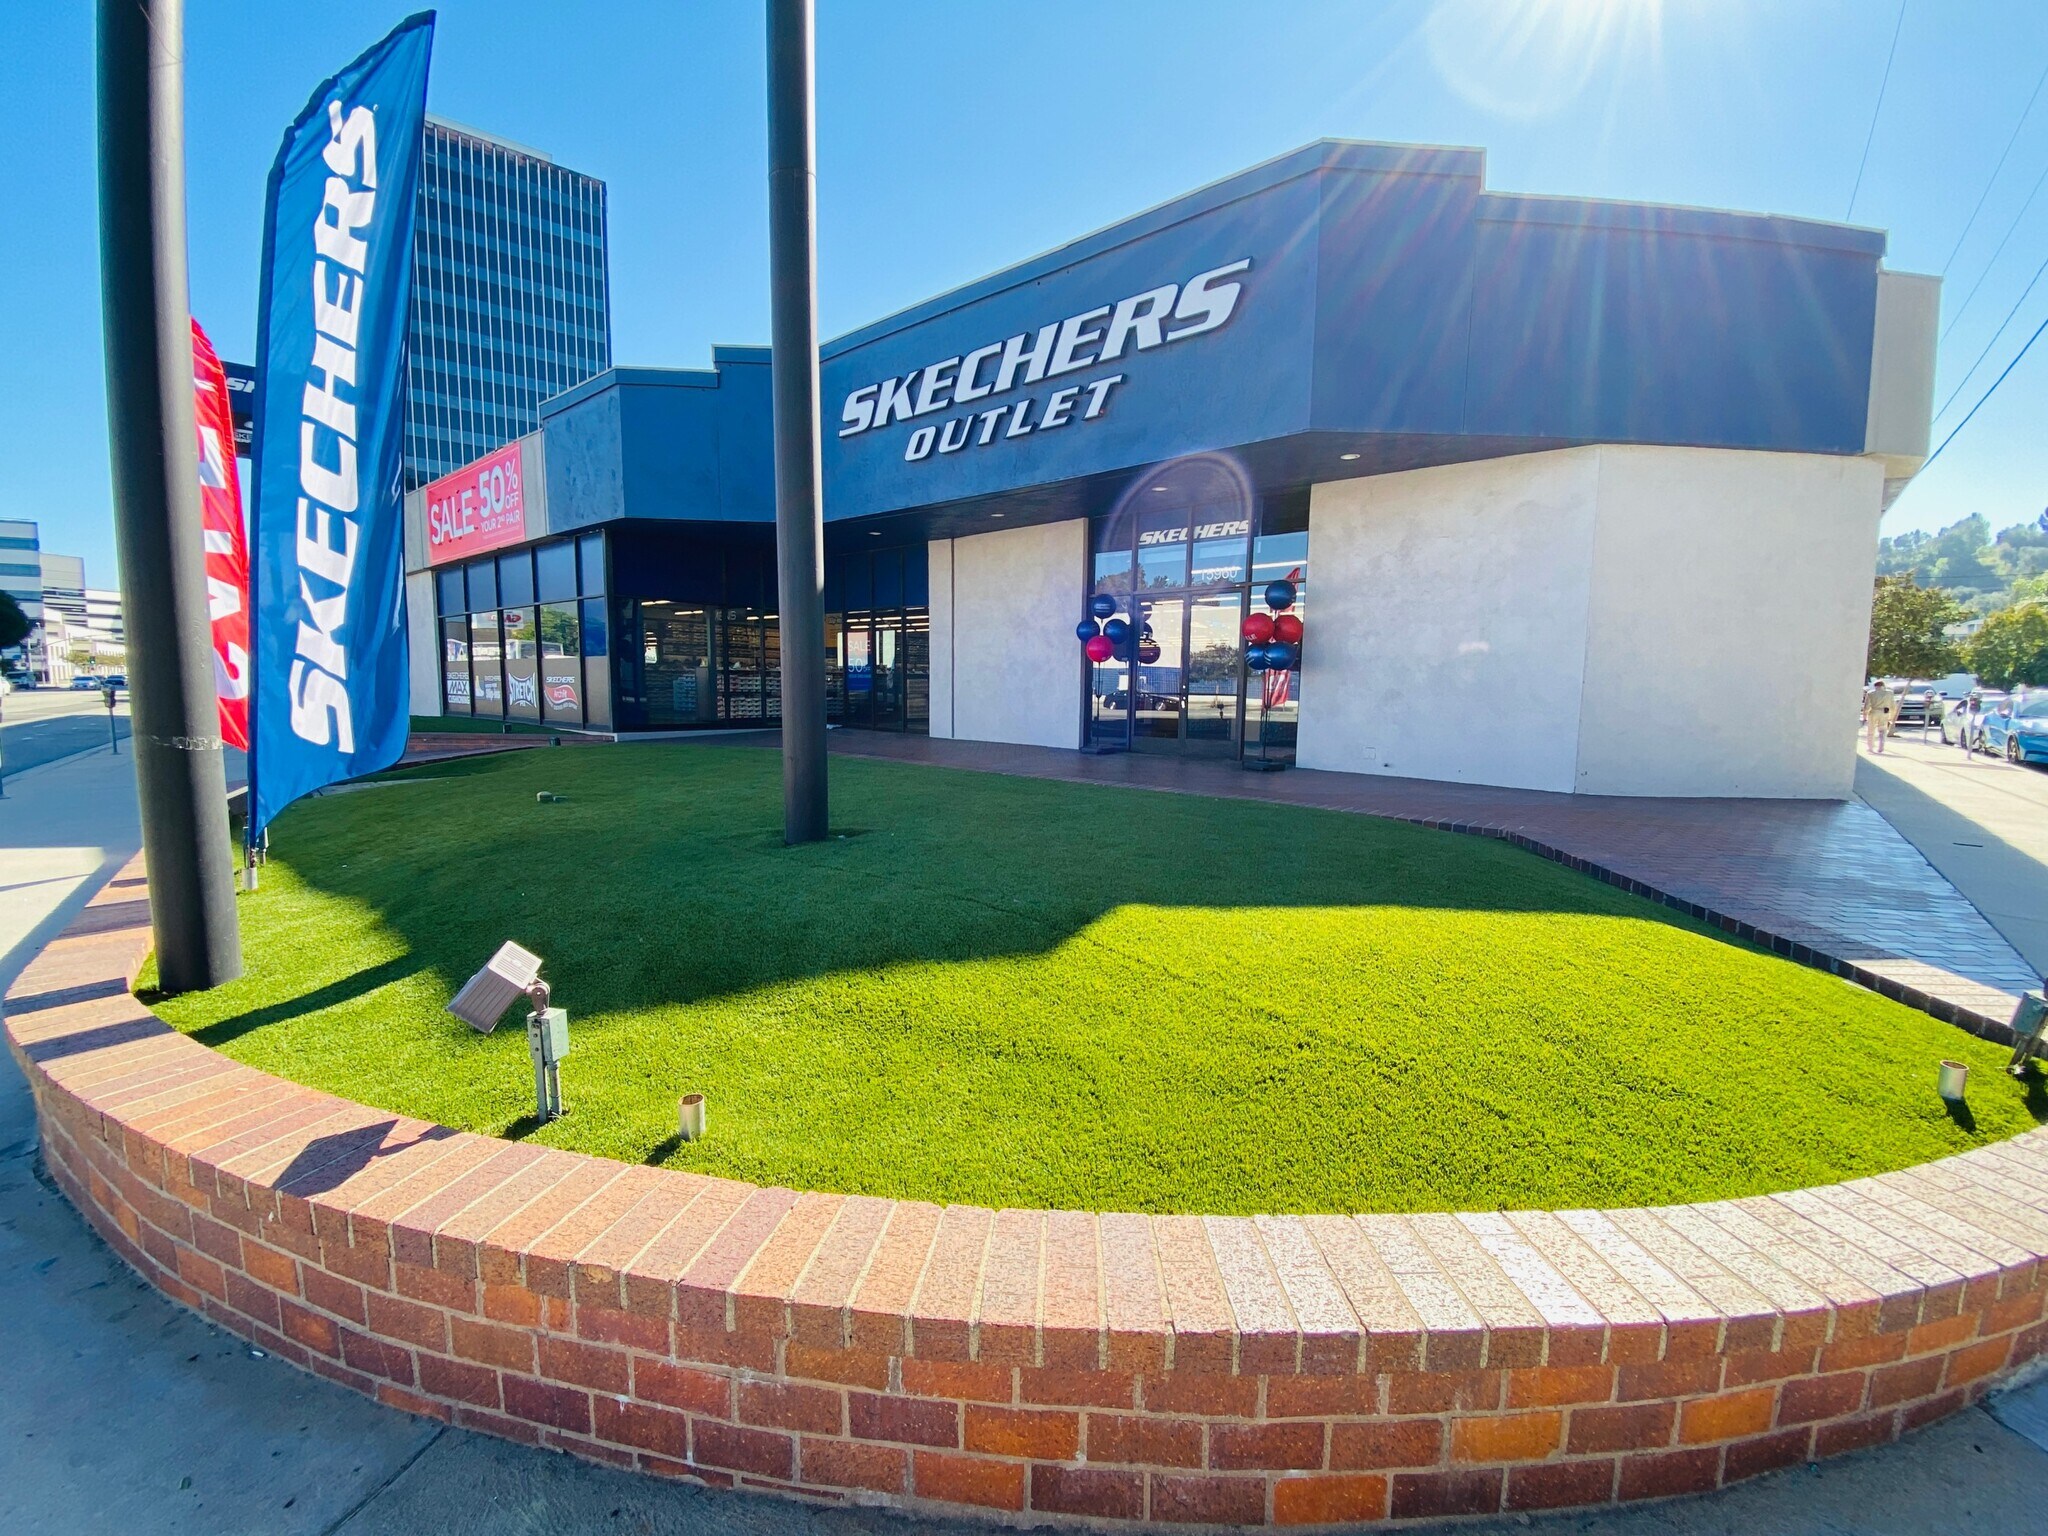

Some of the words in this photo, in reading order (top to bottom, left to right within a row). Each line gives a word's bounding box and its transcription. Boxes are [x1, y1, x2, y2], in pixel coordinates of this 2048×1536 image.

[838, 257, 1252, 438] SKECHERS
[289, 100, 377, 753] SKECHERS
[905, 374, 1126, 462] OUTLET
[431, 489, 475, 545] SALE
[479, 459, 518, 517] 50%
[505, 492, 518, 509] OFF
[481, 518, 496, 533] YOUR
[506, 509, 520, 525] PAIR
[1201, 568, 1238, 580] 15960
[848, 640, 871, 651] SALE
[448, 681, 469, 695] MAX
[508, 672, 536, 706] STRETCH
